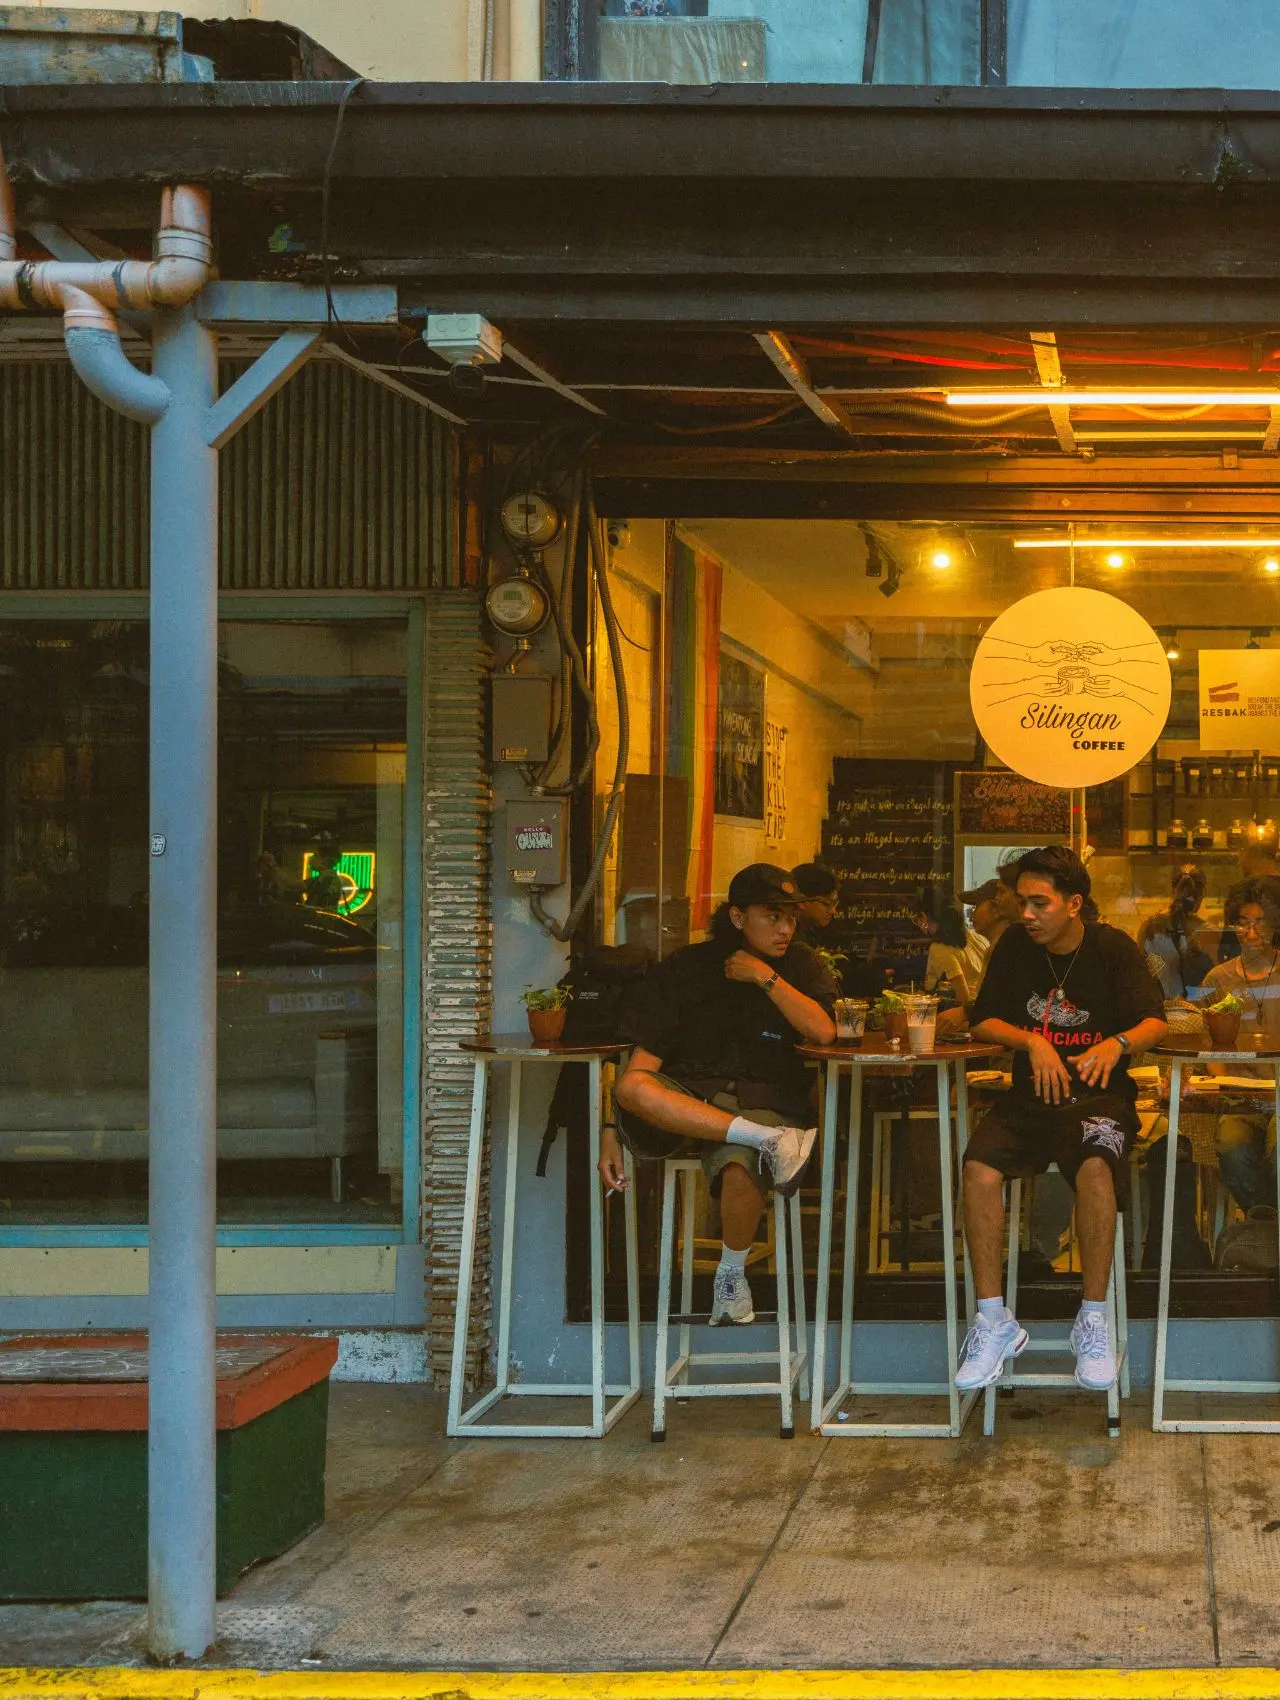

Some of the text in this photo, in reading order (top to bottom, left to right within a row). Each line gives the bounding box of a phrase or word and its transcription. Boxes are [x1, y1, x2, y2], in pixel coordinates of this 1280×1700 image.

[1020, 702, 1121, 738] Silingan
[766, 722, 785, 750] STOP
[1073, 741, 1125, 751] COFFEE
[766, 751, 782, 780] THE
[767, 782, 786, 811] KILL
[831, 834, 844, 846] It's
[864, 832, 893, 849] illegal
[848, 905, 875, 924] illegal
